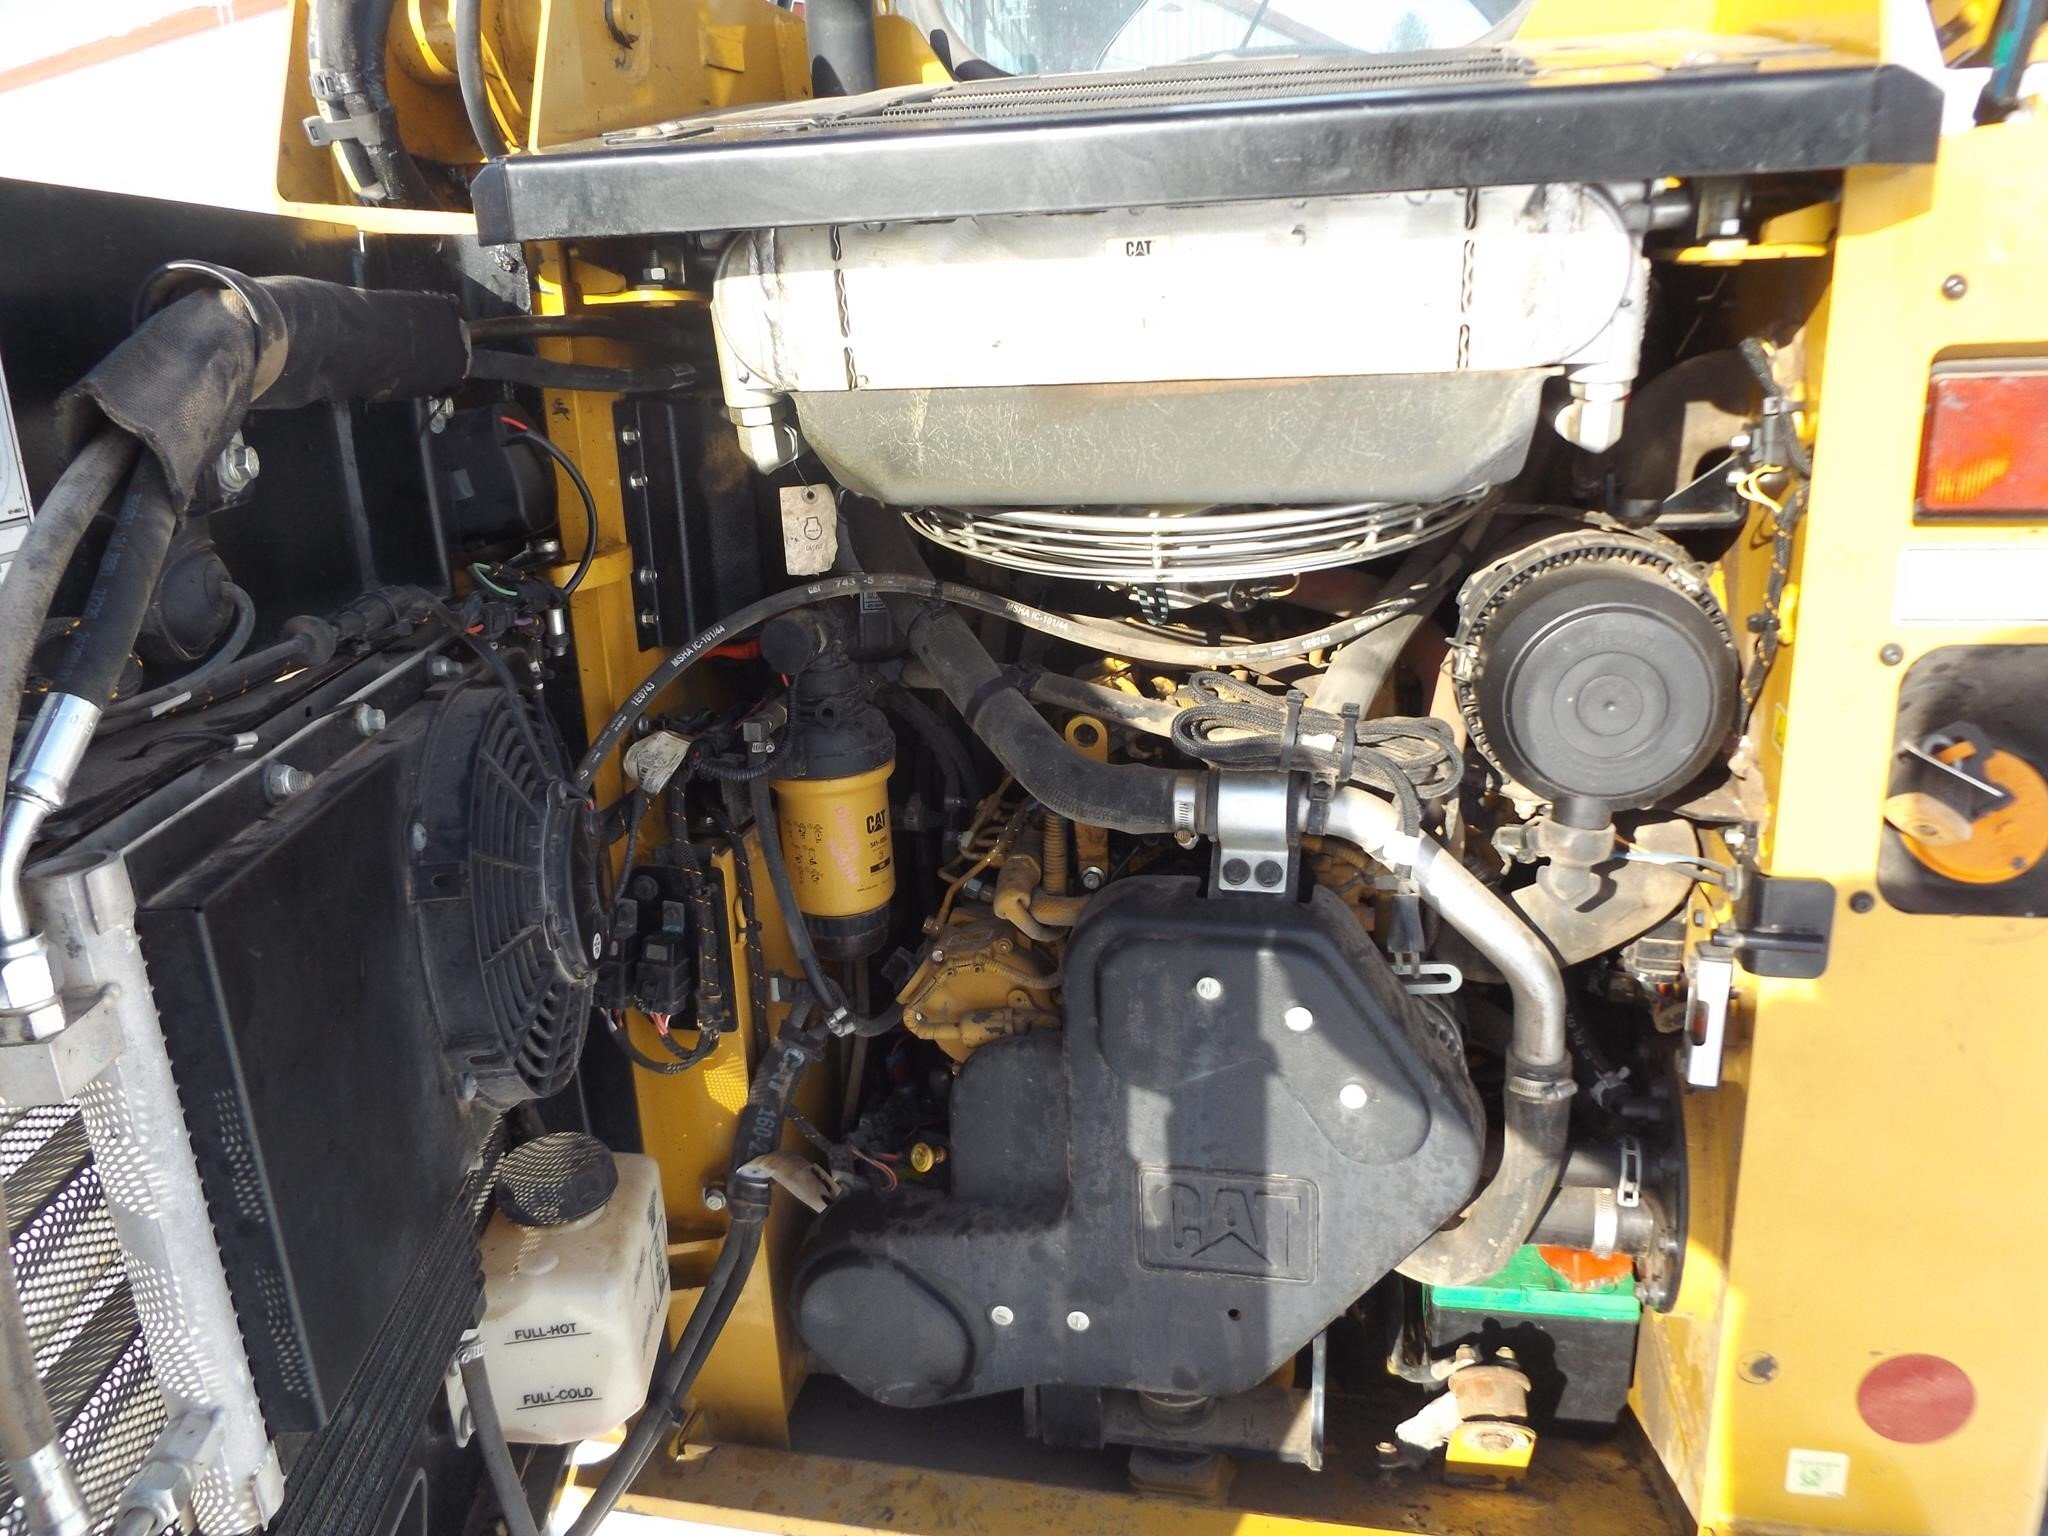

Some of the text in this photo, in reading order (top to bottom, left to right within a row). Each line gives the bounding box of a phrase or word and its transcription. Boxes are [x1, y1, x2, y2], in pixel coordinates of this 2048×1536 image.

[1126, 240, 1152, 257] CAT
[834, 578, 856, 588] 743
[670, 624, 726, 668] MSHA IC-101/44
[631, 681, 656, 707] 1E0743
[866, 809, 886, 835] CAT
[1151, 1182, 1302, 1268] CAT
[514, 1322, 578, 1341] FULL-HOT
[522, 1386, 594, 1405] FULL-COLD
